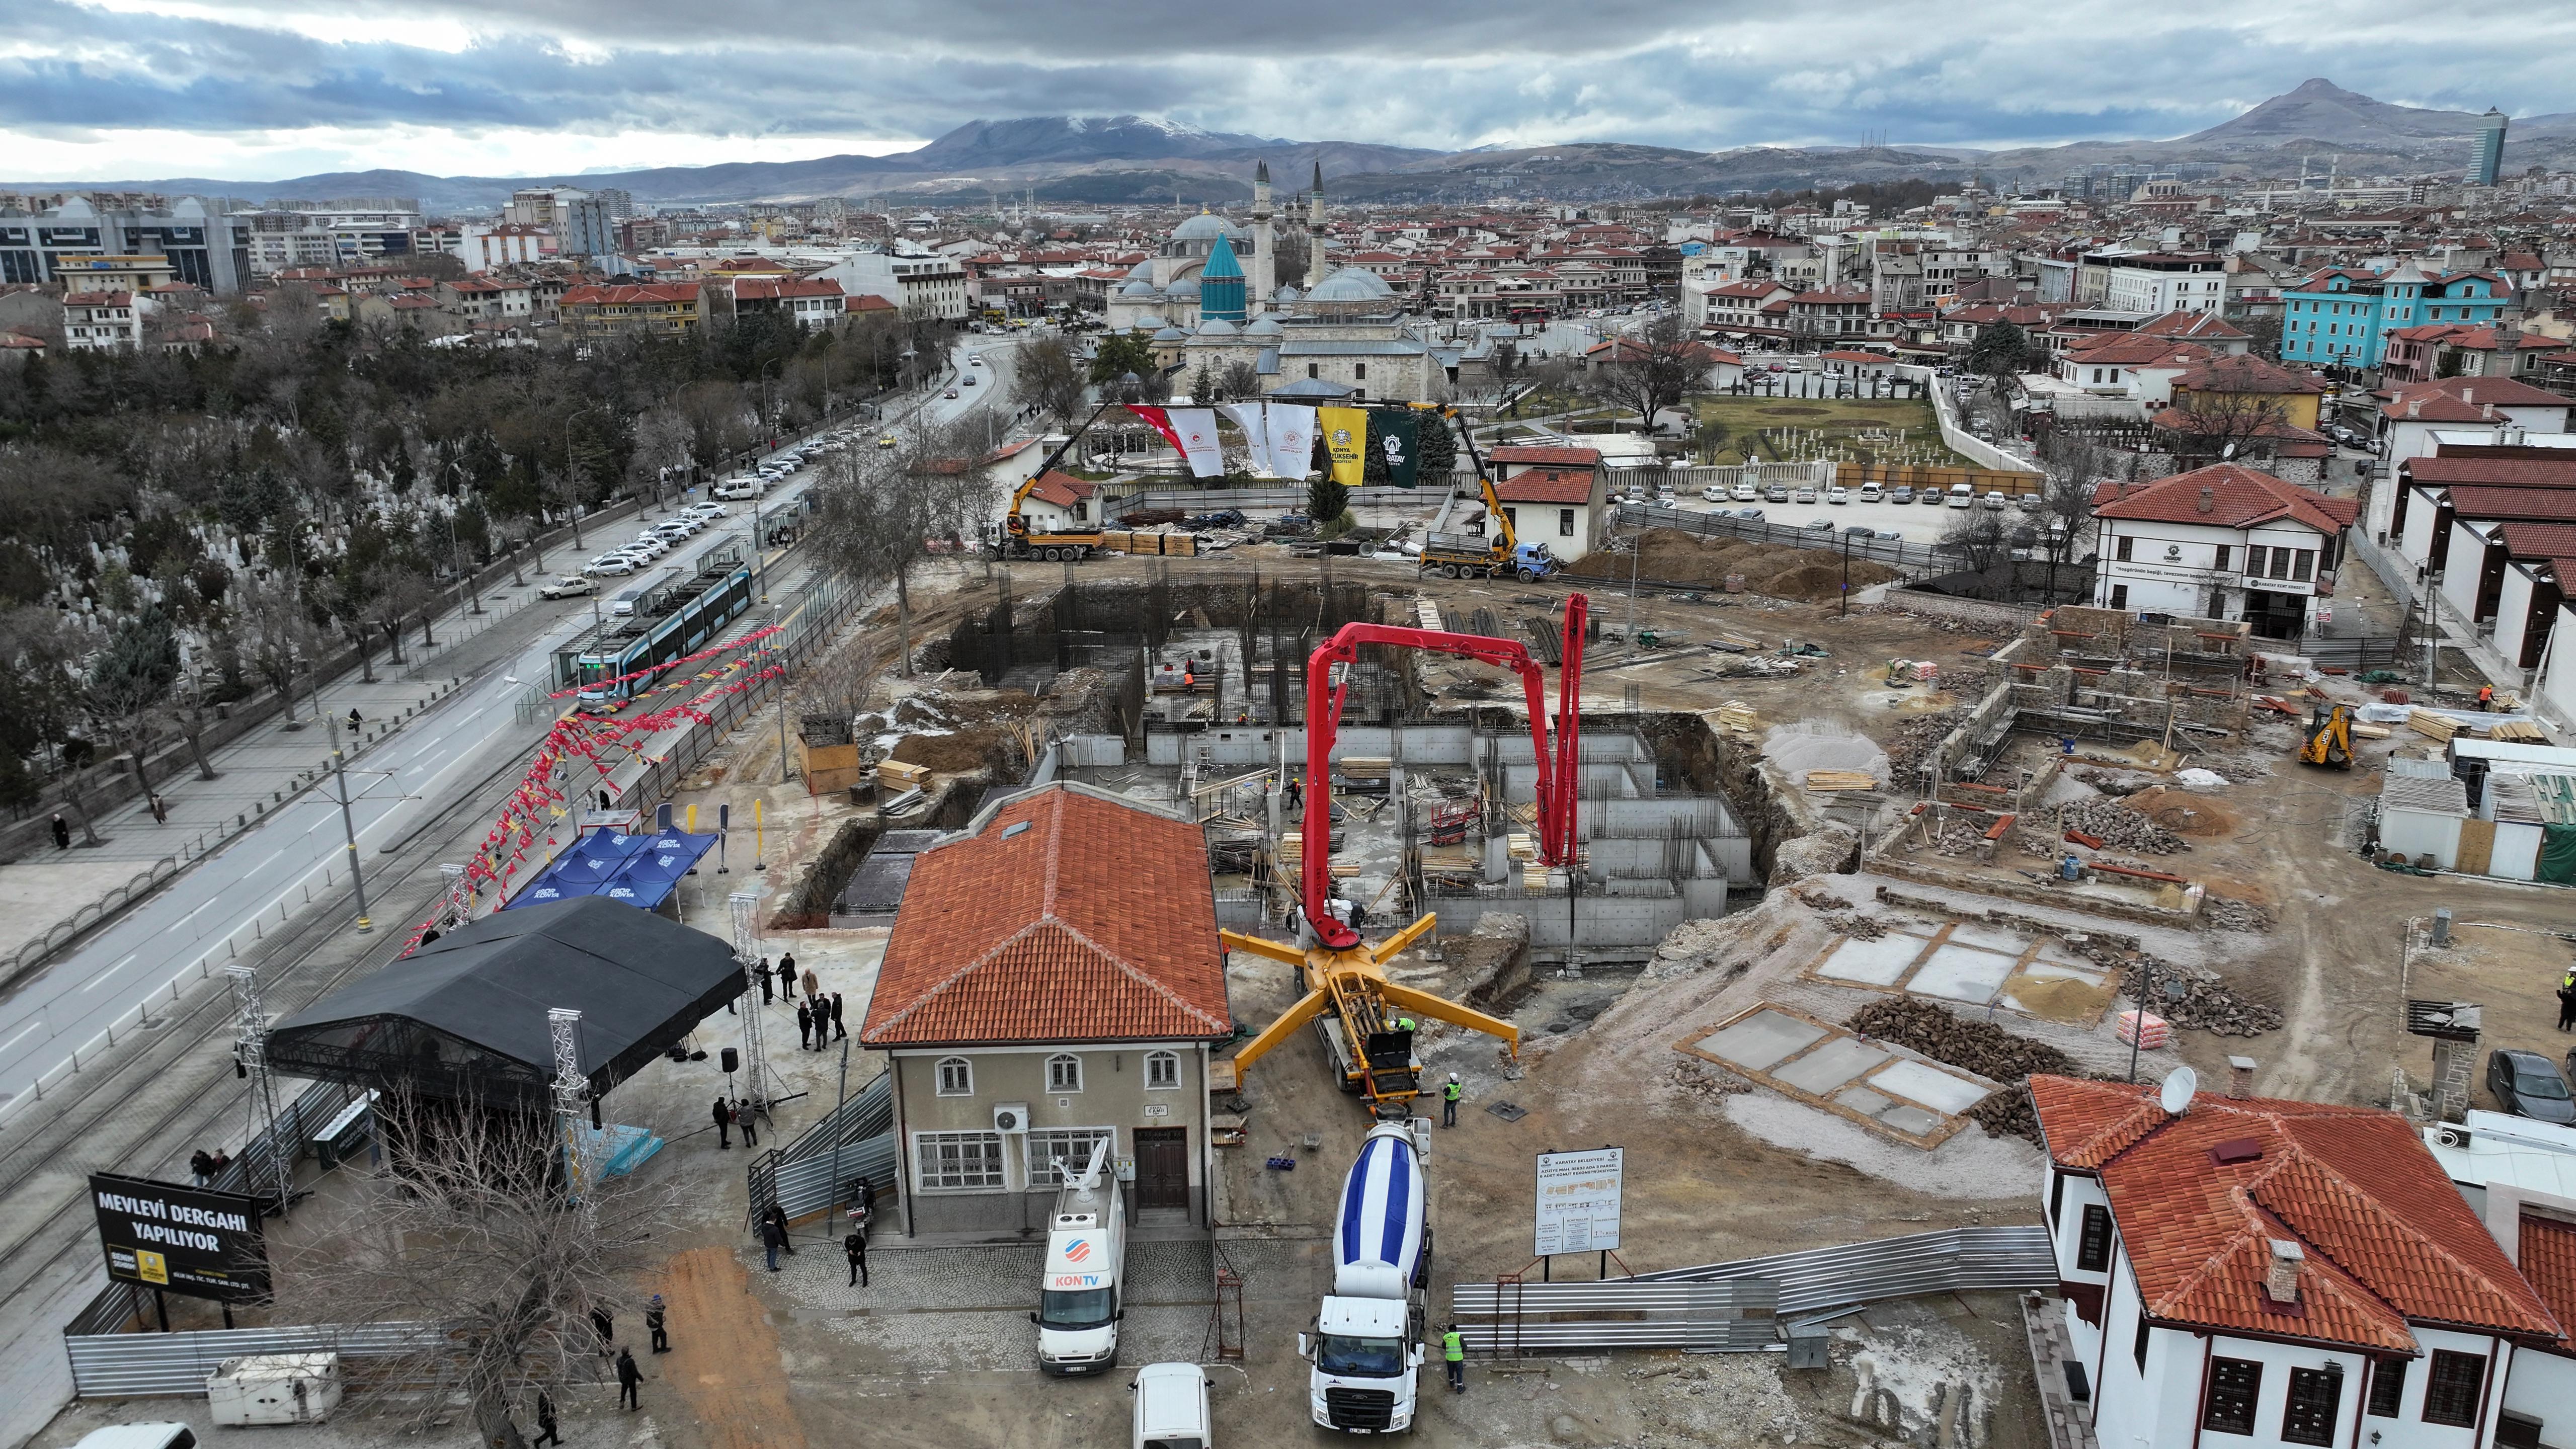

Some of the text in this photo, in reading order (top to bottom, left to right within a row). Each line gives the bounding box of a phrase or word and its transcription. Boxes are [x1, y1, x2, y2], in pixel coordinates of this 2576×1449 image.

[1386, 454, 1405, 463] RATAY
[2321, 729, 2330, 745] JCB
[98, 1192, 247, 1232] MEVLEVİ DERGAHI
[132, 1222, 220, 1252] YAPILIYOR
